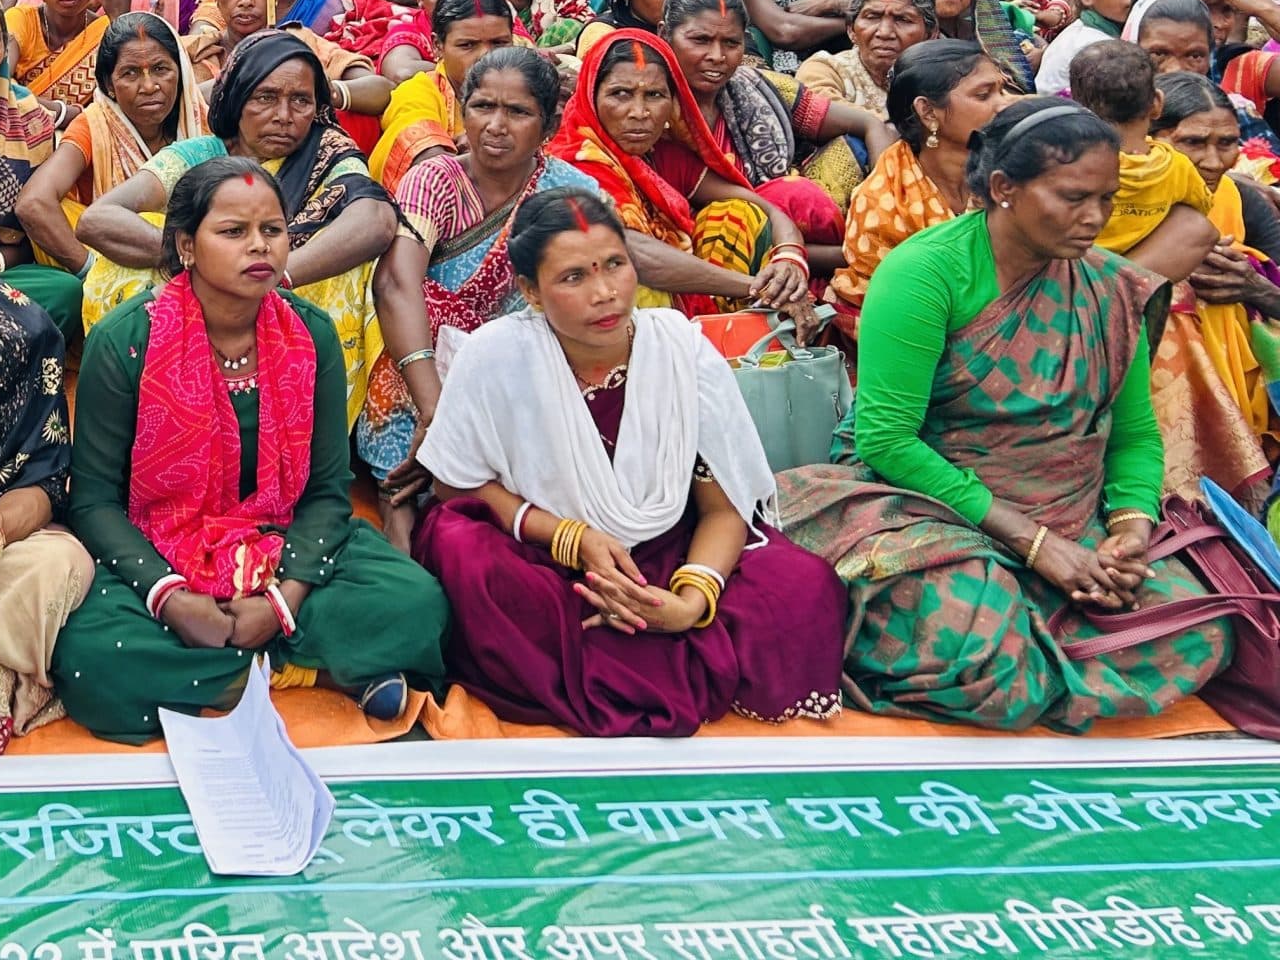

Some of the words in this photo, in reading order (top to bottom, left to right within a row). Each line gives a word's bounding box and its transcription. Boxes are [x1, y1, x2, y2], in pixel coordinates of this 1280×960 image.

[336, 793, 504, 847] लेकर
[510, 789, 590, 846] ही
[596, 798, 785, 841] वापस
[786, 797, 902, 836] घर
[894, 781, 1000, 835] की
[1003, 780, 1141, 833] ओर
[439, 912, 531, 960] और
[542, 923, 648, 960] अपर
[655, 903, 851, 960] समाहर्ता
[846, 901, 1018, 957] महोदय
[1005, 895, 1206, 954] गिरिडीह
[1190, 893, 1252, 945] के
